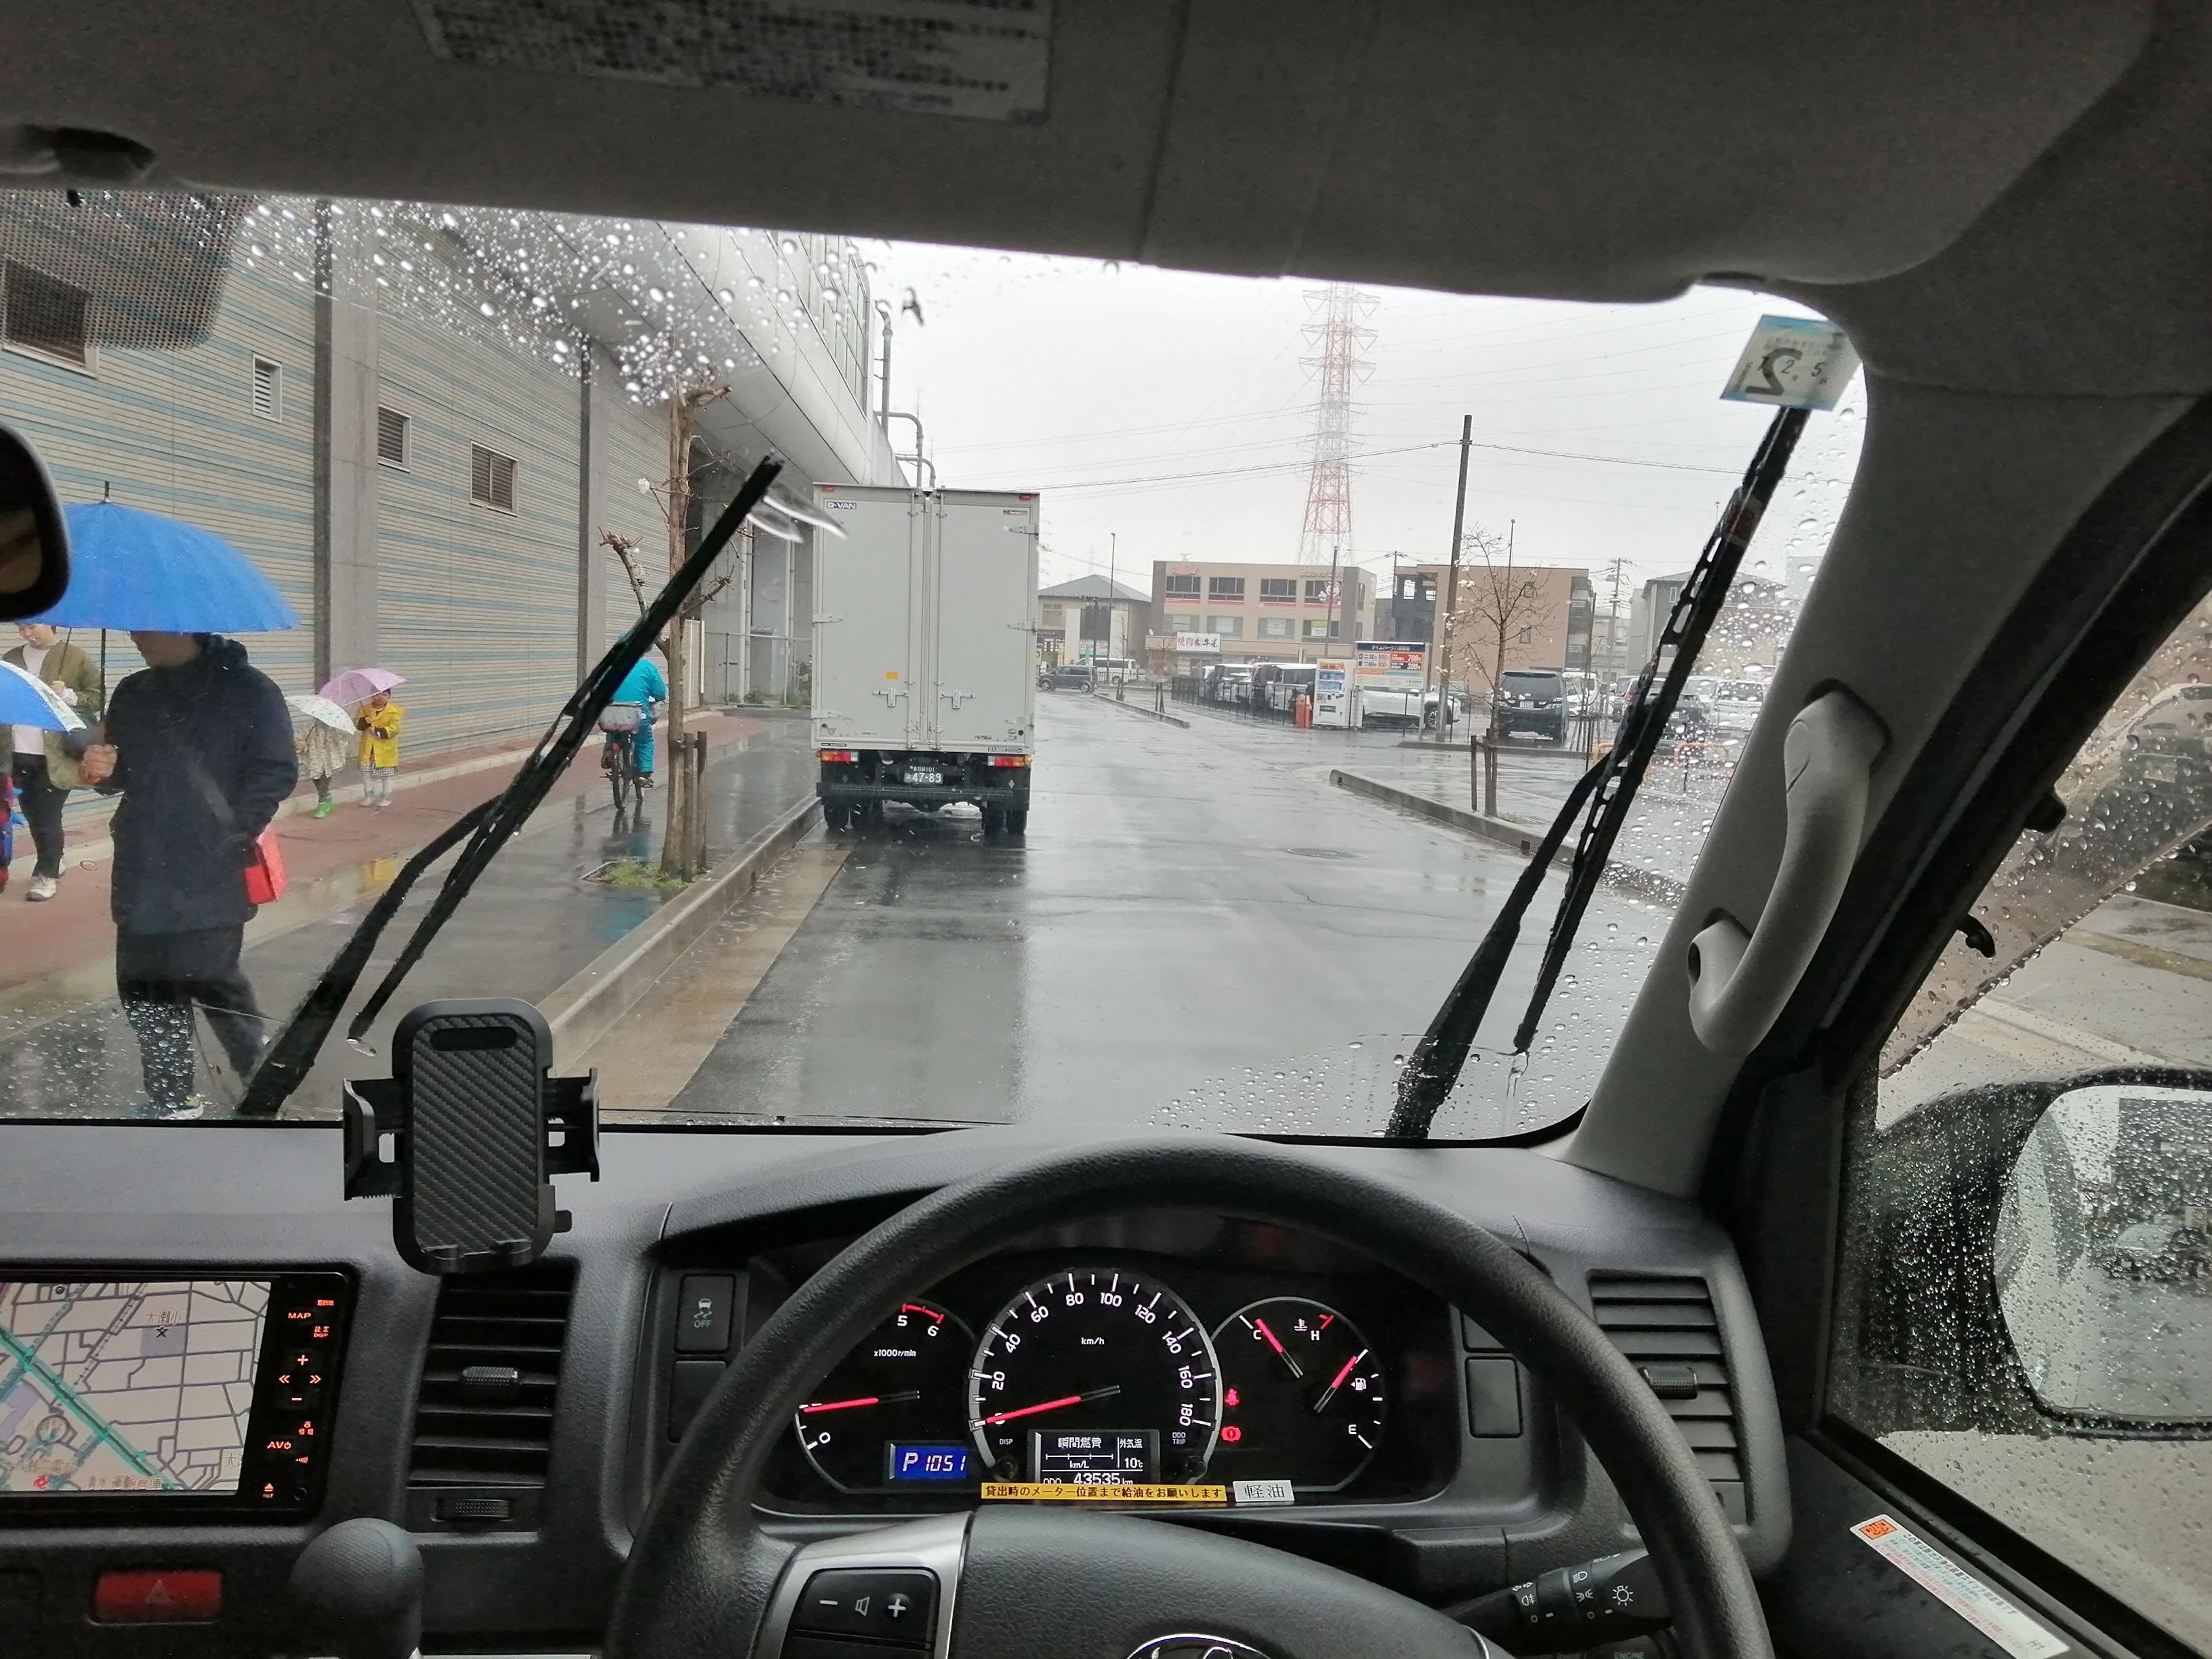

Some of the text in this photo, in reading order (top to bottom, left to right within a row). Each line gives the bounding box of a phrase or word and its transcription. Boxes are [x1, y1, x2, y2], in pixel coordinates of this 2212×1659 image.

[1066, 1292, 1084, 1306] 80
[1101, 1292, 1122, 1307] 100
[897, 1315, 907, 1326] 5
[1031, 1306, 1048, 1323] 60
[1134, 1305, 1156, 1324] 120
[694, 1320, 712, 1328] OFF
[927, 1326, 939, 1336] 6
[1253, 1330, 1262, 1340] C
[1311, 1331, 1320, 1340] H
[1006, 1334, 1021, 1353] 40
[1081, 1337, 1105, 1345] km/h
[1162, 1332, 1181, 1353] 140
[992, 1372, 1006, 1391] 20
[1178, 1366, 1193, 1389] 160
[1179, 1404, 1193, 1427] 180
[1349, 1425, 1357, 1434] E
[819, 1432, 831, 1443] 0
[1058, 1437, 1102, 1449] 瞬間燃費
[1120, 1438, 1143, 1448] 外気温
[903, 1452, 918, 1472] P
[1069, 1460, 1089, 1469] km/L
[1073, 1473, 1120, 1485] 43535
[1244, 1484, 1285, 1499] 軽油
